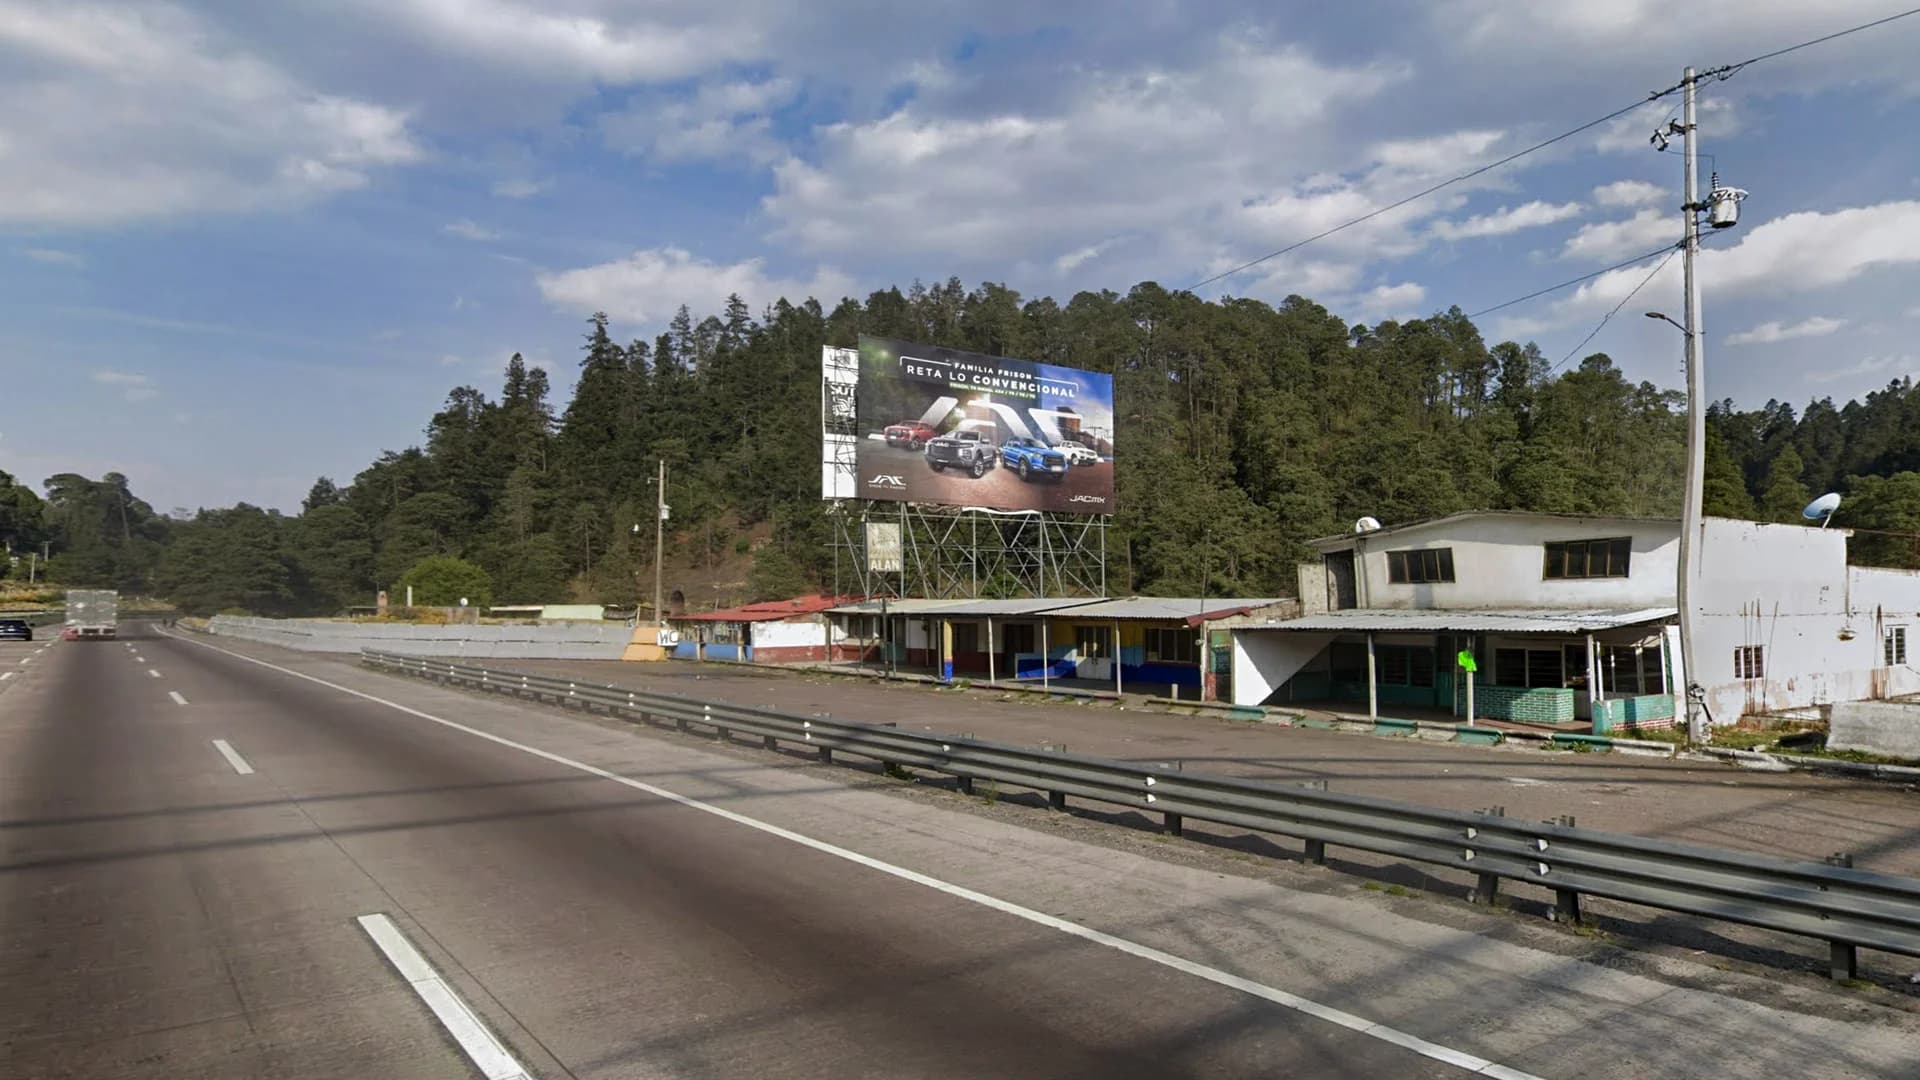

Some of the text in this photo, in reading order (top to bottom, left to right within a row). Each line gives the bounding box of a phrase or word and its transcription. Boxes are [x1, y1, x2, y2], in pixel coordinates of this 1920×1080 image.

[954, 362, 1032, 380] FAMILIA FRISON
[907, 365, 942, 379] RETA
[949, 371, 966, 381] LO
[973, 375, 1075, 398] CONVENCIONAL
[871, 559, 900, 571] ALAN
[659, 630, 680, 644] WC
